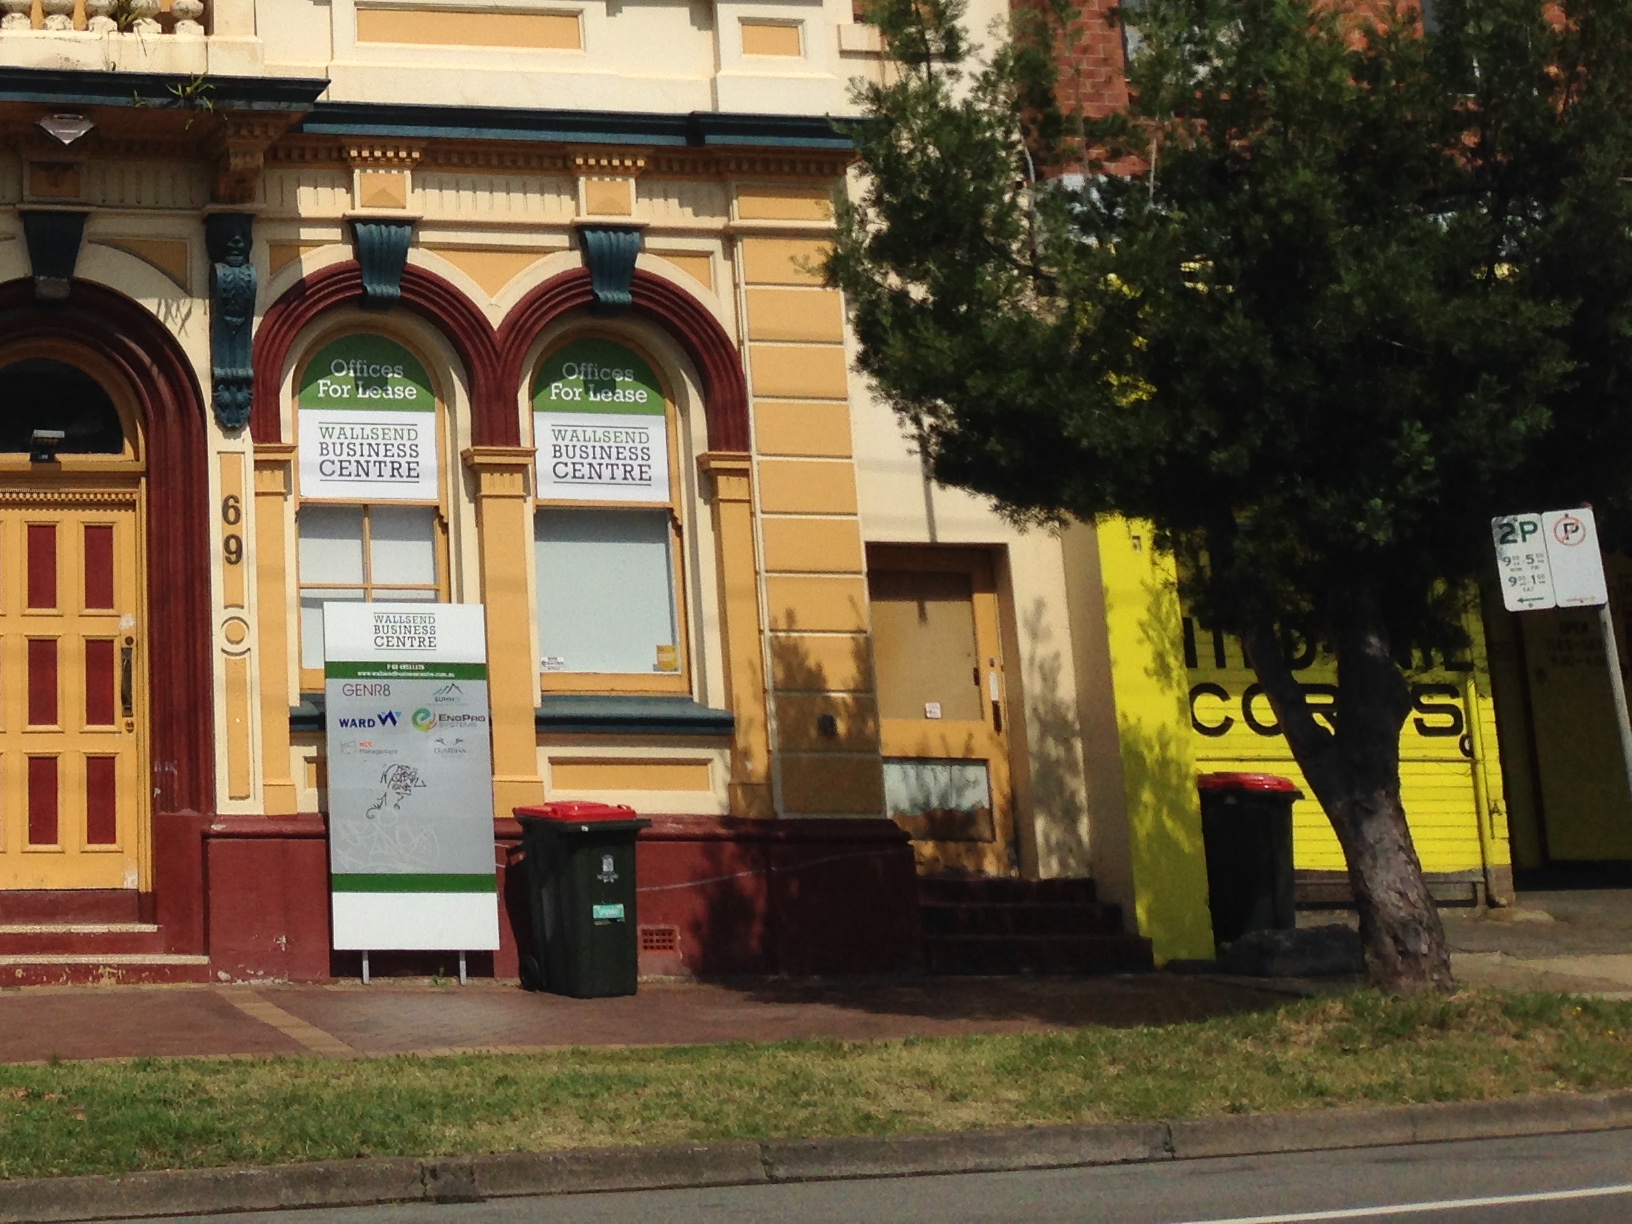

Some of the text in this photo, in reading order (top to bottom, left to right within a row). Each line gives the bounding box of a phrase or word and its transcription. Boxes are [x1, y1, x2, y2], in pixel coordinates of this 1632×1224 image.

[331, 359, 404, 378] Offices
[562, 362, 634, 381] Offices
[317, 380, 417, 400] For Lease
[549, 383, 648, 403] For Lease
[319, 426, 418, 442] WALLSEND
[552, 429, 650, 444] WALLSEND
[319, 442, 419, 459] BUSINESS
[552, 445, 651, 461] BUSINESS
[318, 459, 419, 479] CENTRE
[552, 462, 652, 482] CENTRE
[1498, 521, 1538, 544] 2P
[374, 615, 436, 624] WALLSEND
[374, 625, 436, 635] BUSINESS
[374, 636, 437, 648] CENTRE
[342, 683, 391, 697] GENR8
[339, 718, 376, 728] WARD
